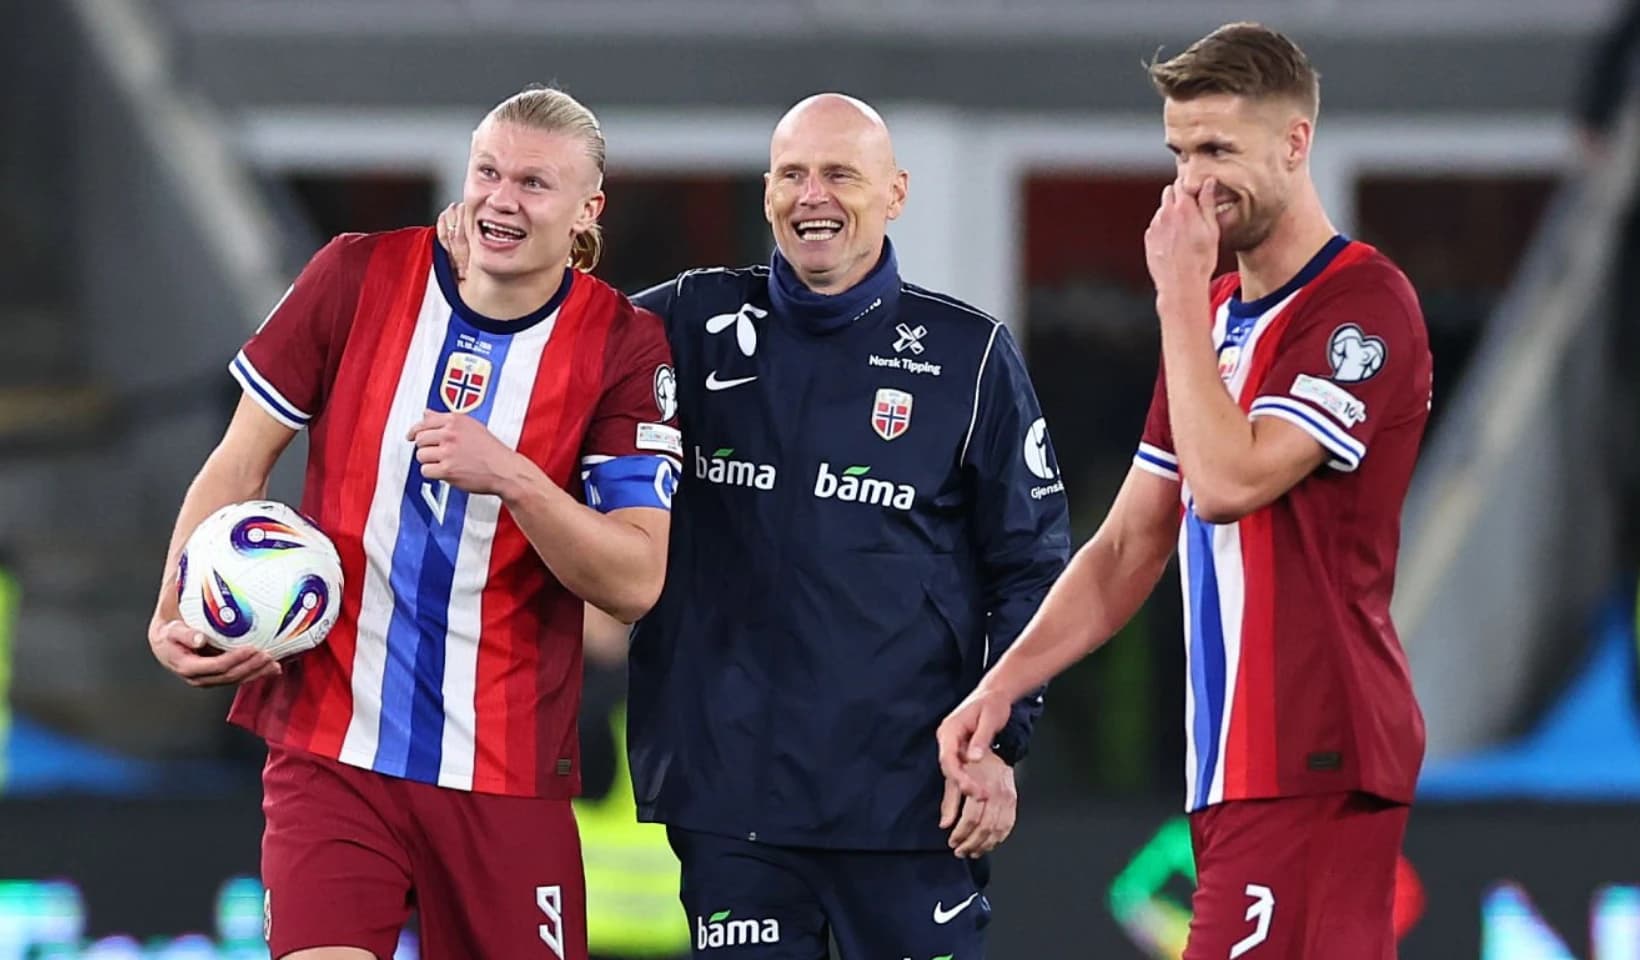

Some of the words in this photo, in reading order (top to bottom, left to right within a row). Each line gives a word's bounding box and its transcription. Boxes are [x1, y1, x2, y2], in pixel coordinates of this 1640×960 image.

[869, 354, 900, 368] Norsk
[902, 358, 942, 376] Tipping
[695, 446, 776, 490] bama
[814, 463, 916, 510] bama
[536, 885, 564, 960] 9
[698, 913, 779, 950] bama
[1230, 884, 1274, 959] 3
